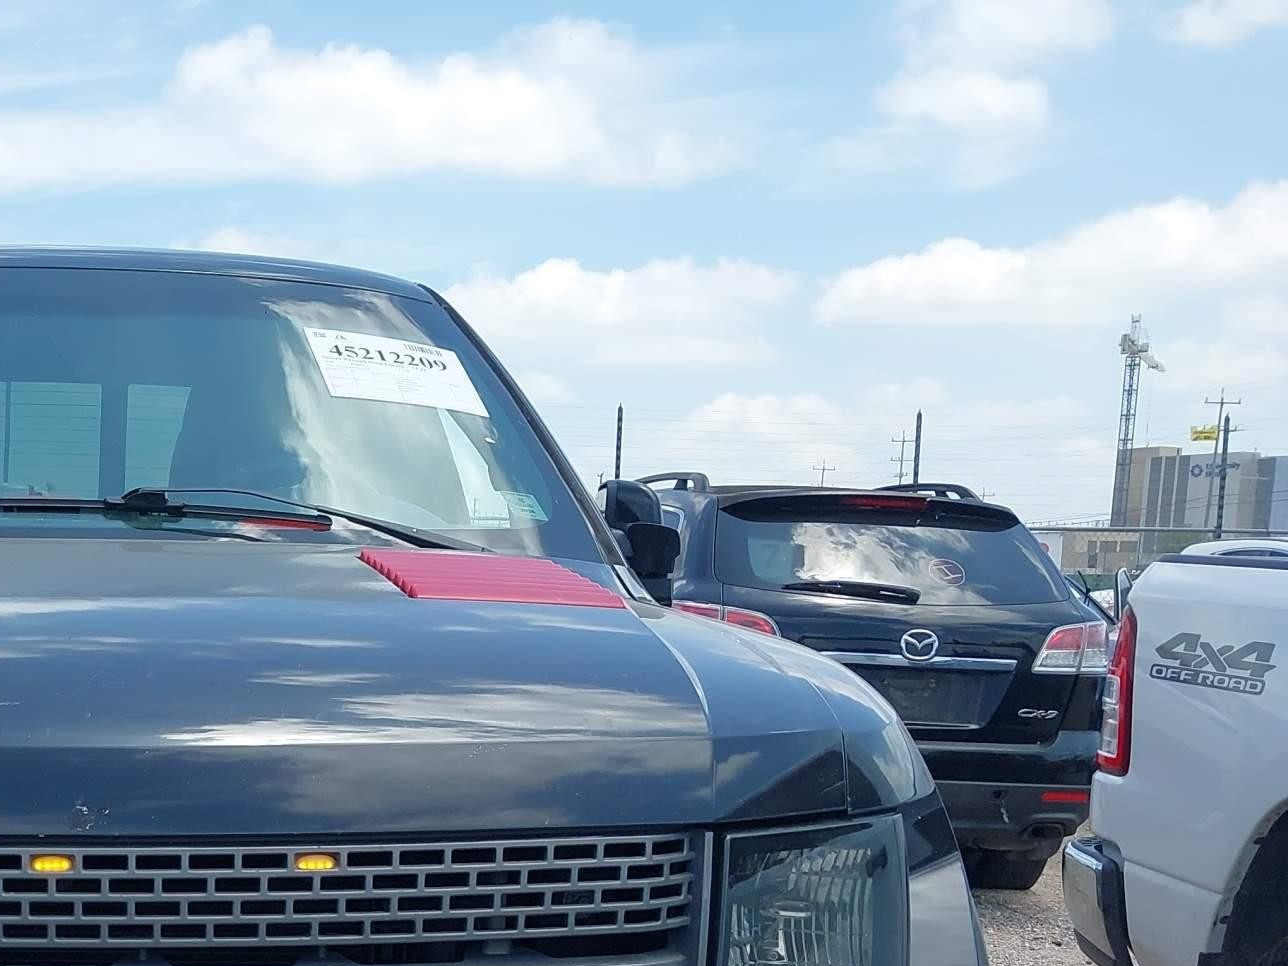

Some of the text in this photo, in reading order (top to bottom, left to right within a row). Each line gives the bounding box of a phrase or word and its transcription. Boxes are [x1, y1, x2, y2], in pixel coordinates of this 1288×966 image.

[328, 344, 448, 372] 45212209
[1151, 665, 1264, 694] OFF ROAD
